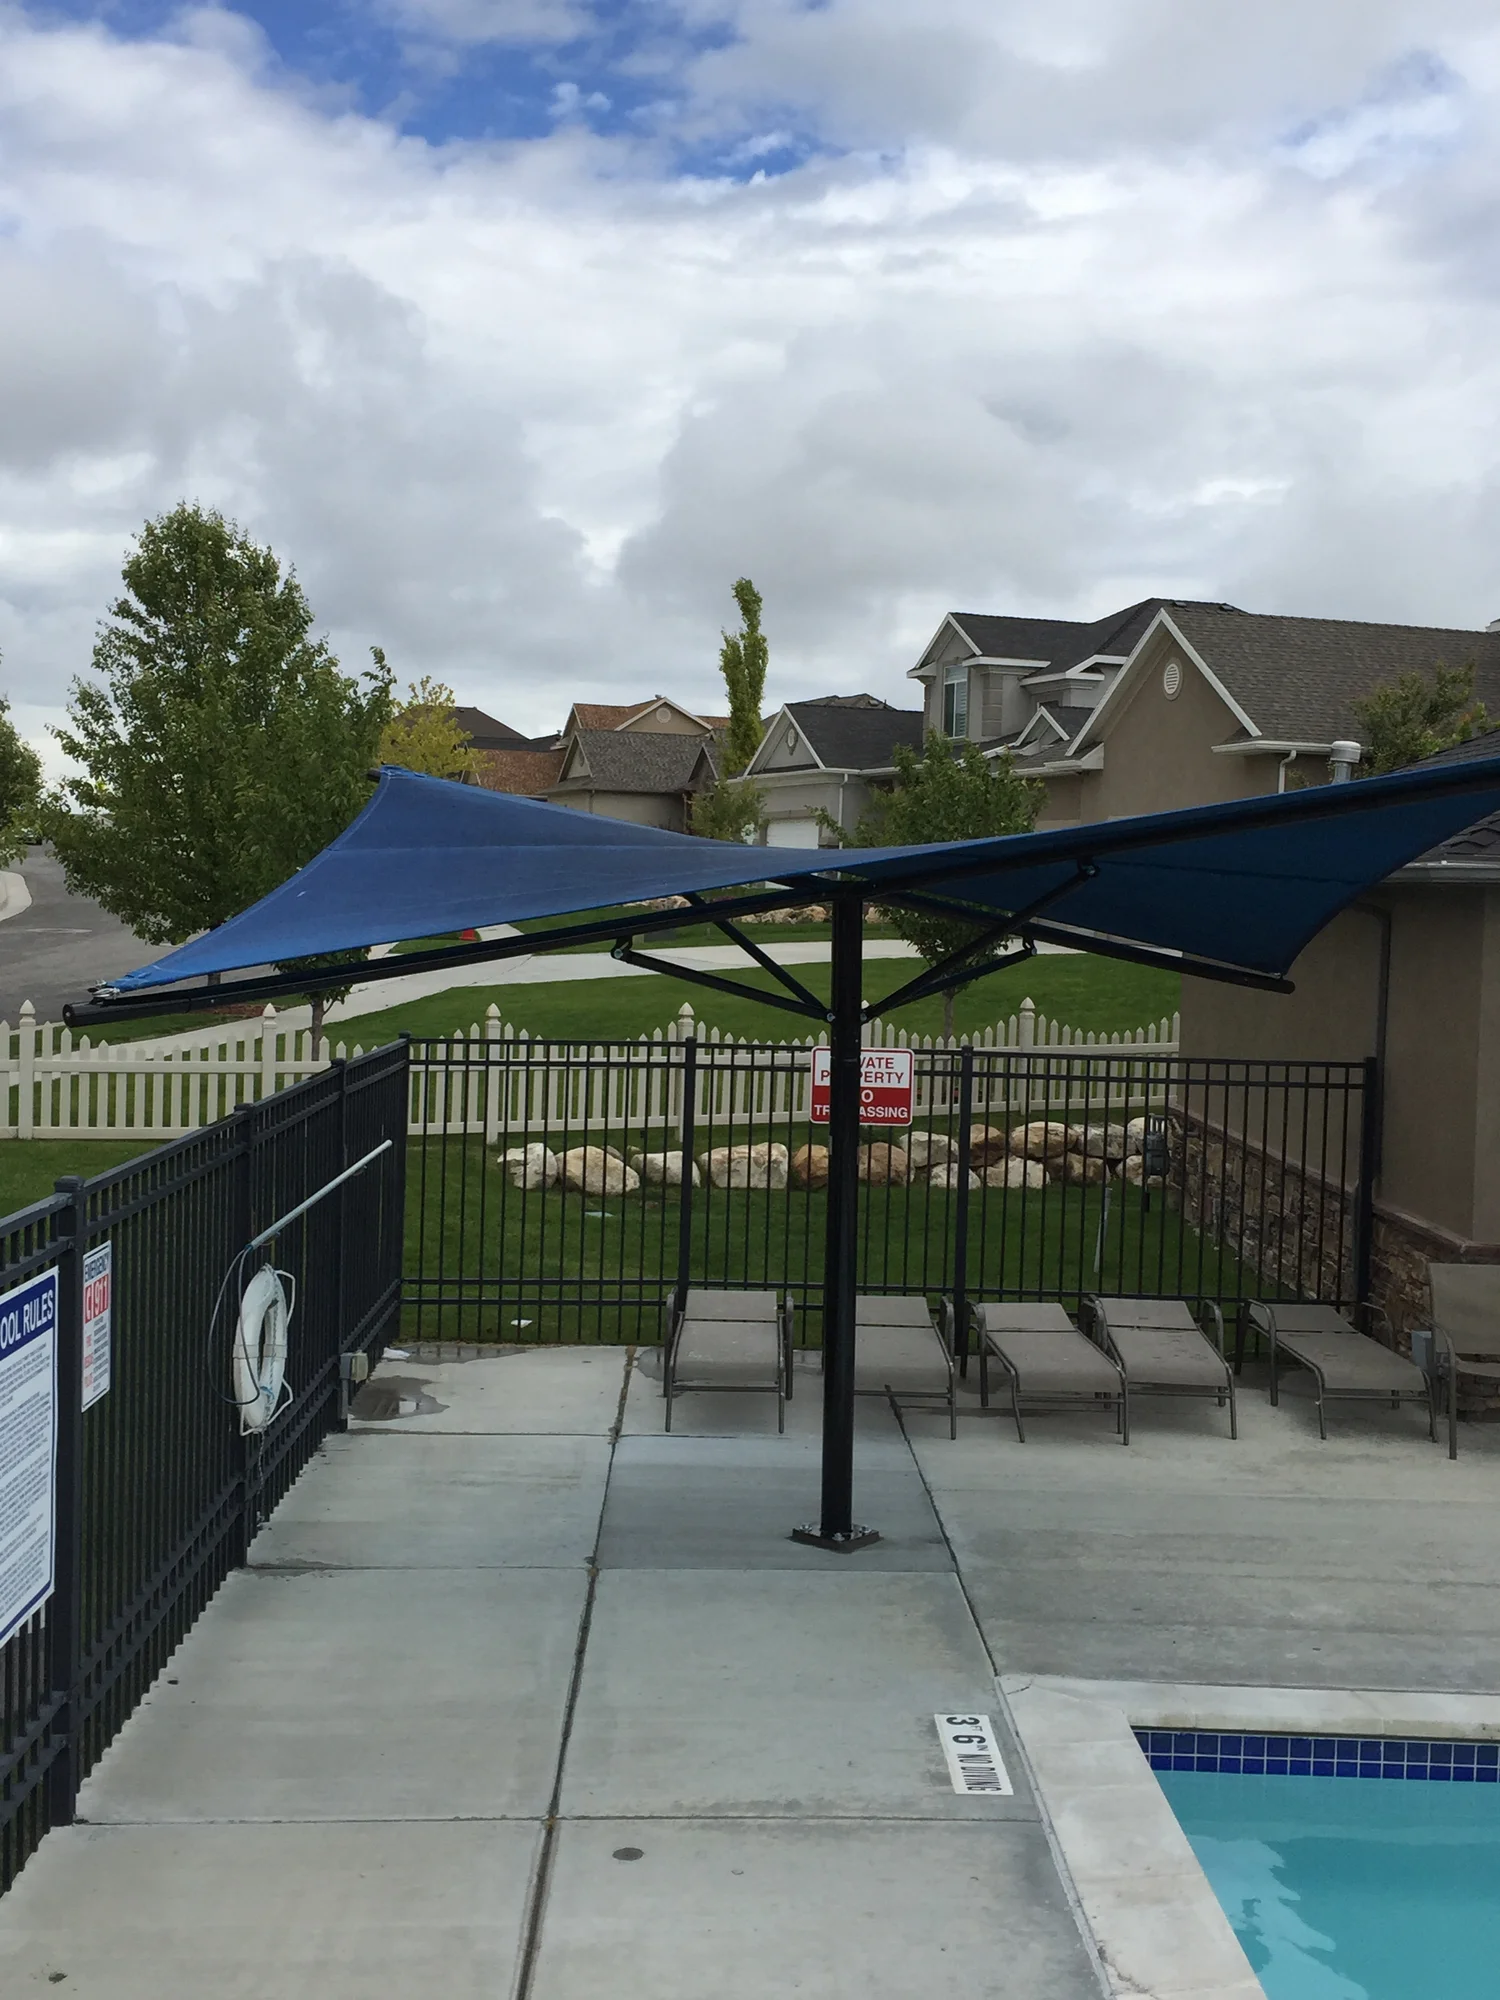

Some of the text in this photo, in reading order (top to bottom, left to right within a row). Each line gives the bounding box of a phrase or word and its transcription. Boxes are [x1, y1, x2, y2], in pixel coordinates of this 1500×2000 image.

[859, 1057, 894, 1069] VATE
[820, 1070, 904, 1083] PERTY
[861, 1090, 874, 1103] O
[814, 1104, 908, 1118] TRASSING
[94, 1275, 108, 1316] 911
[0, 1289, 53, 1350] OOL RULES
[946, 1717, 980, 1725] 3
[952, 1735, 986, 1744] 6
[957, 1753, 993, 1764] NO
[960, 1767, 1002, 1791] DIVING
